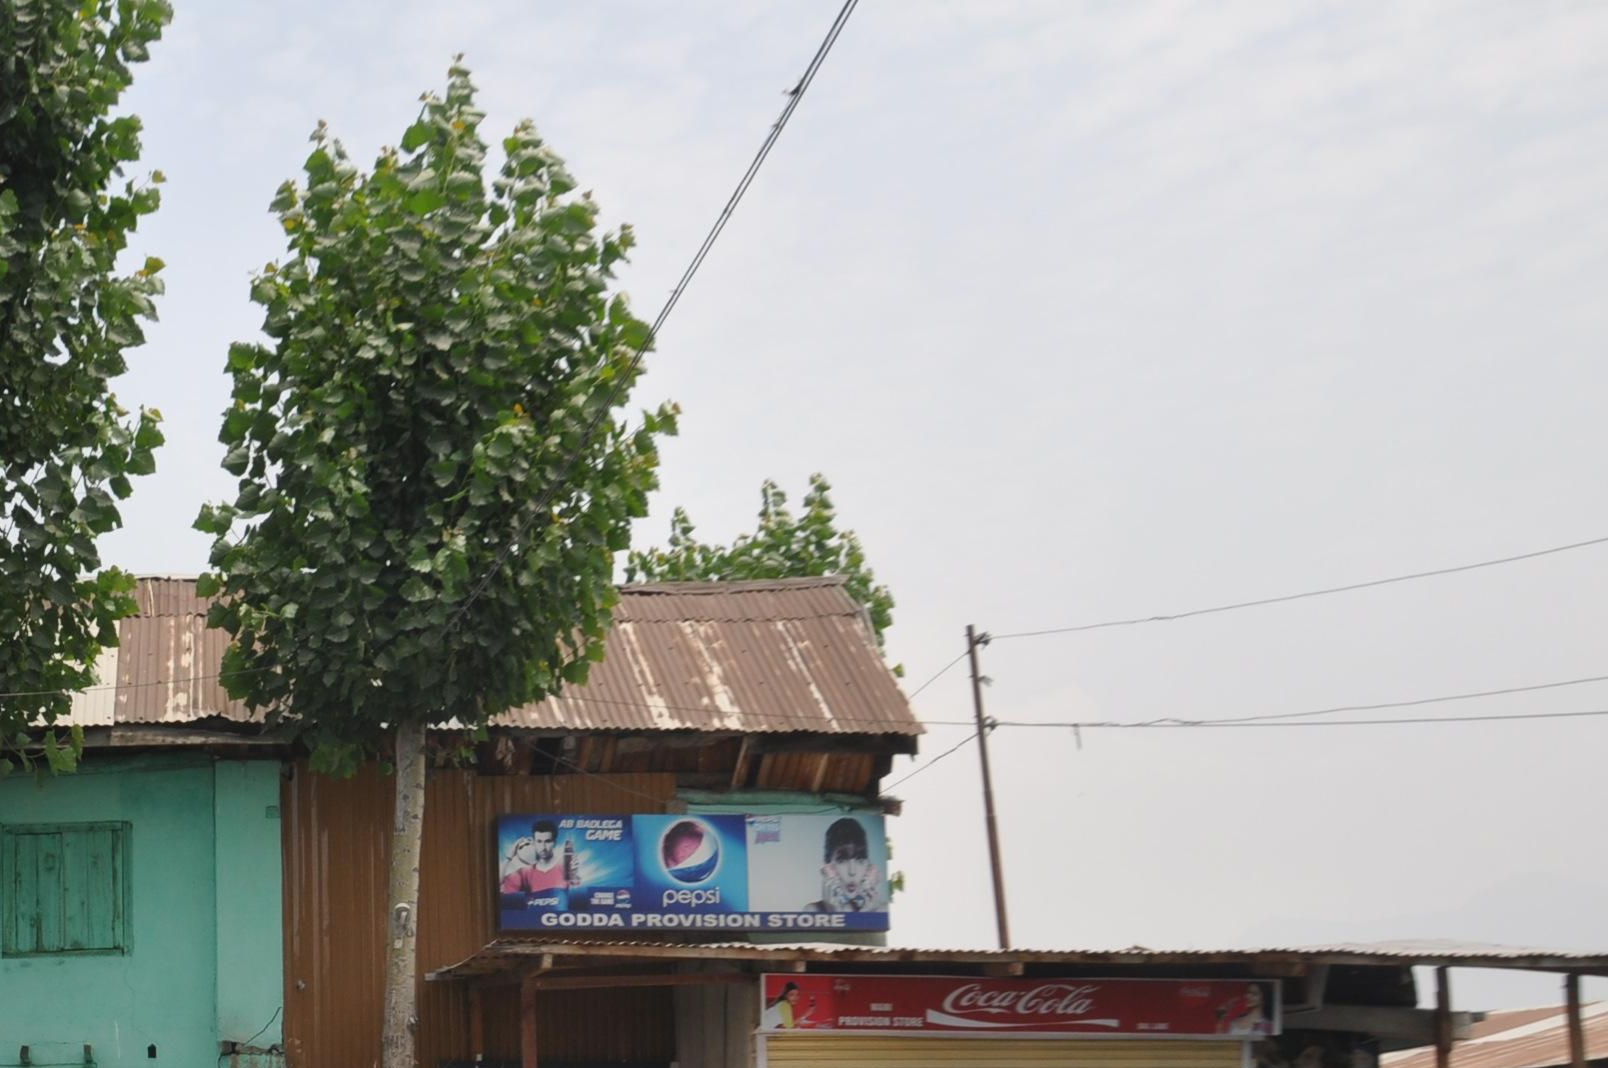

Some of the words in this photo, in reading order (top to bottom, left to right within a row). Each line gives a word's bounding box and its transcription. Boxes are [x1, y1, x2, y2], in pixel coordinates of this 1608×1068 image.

[586, 829, 623, 841] GAME
[663, 887, 721, 907] pepsi
[541, 912, 624, 927] GODDA
[631, 913, 761, 928] PROVISION
[767, 913, 847, 928] STORE
[943, 983, 1104, 1014] Coca-Cola
